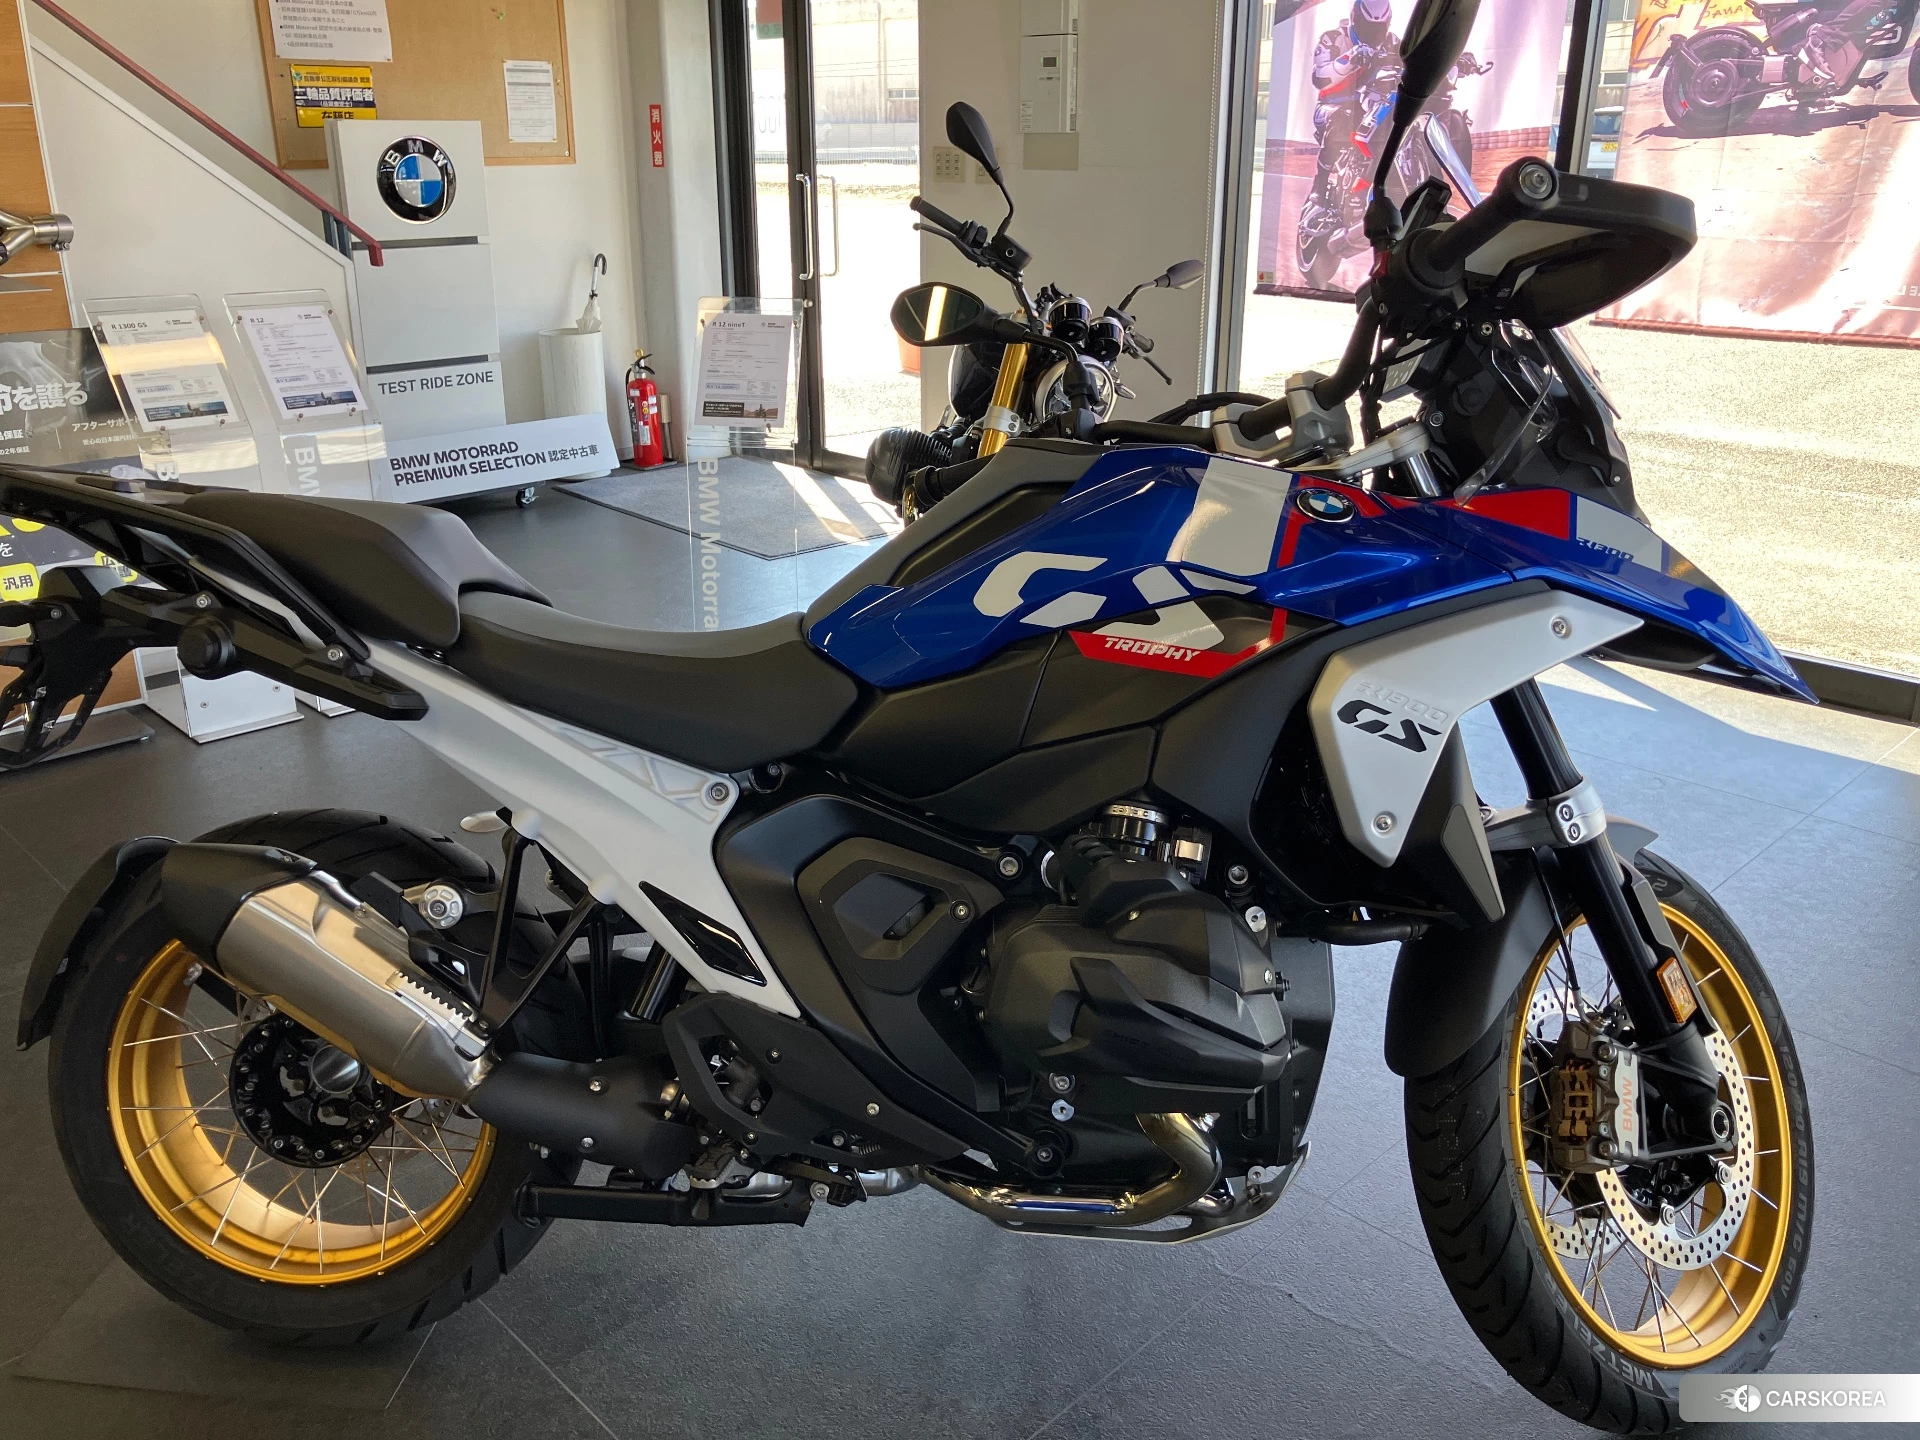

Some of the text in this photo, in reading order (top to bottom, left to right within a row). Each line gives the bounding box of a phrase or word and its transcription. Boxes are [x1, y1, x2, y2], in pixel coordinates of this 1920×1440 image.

[384, 140, 447, 167] BMW
[651, 108, 663, 166] 消火器
[378, 371, 494, 395] TEST RIDE ZONE
[390, 441, 519, 471] BMW MOTORRAD
[394, 444, 599, 486] PREMIUM SELECTION 認定中古車
[698, 457, 721, 632] BMW Motorra
[3, 574, 34, 590] 汎用
[973, 551, 1257, 650] GS
[1104, 636, 1200, 662] TROPHY
[1355, 680, 1449, 724] R1300
[1337, 700, 1442, 753] GS
[1623, 1076, 1633, 1132] BMW
[1544, 1272, 1655, 1391] METZELER
